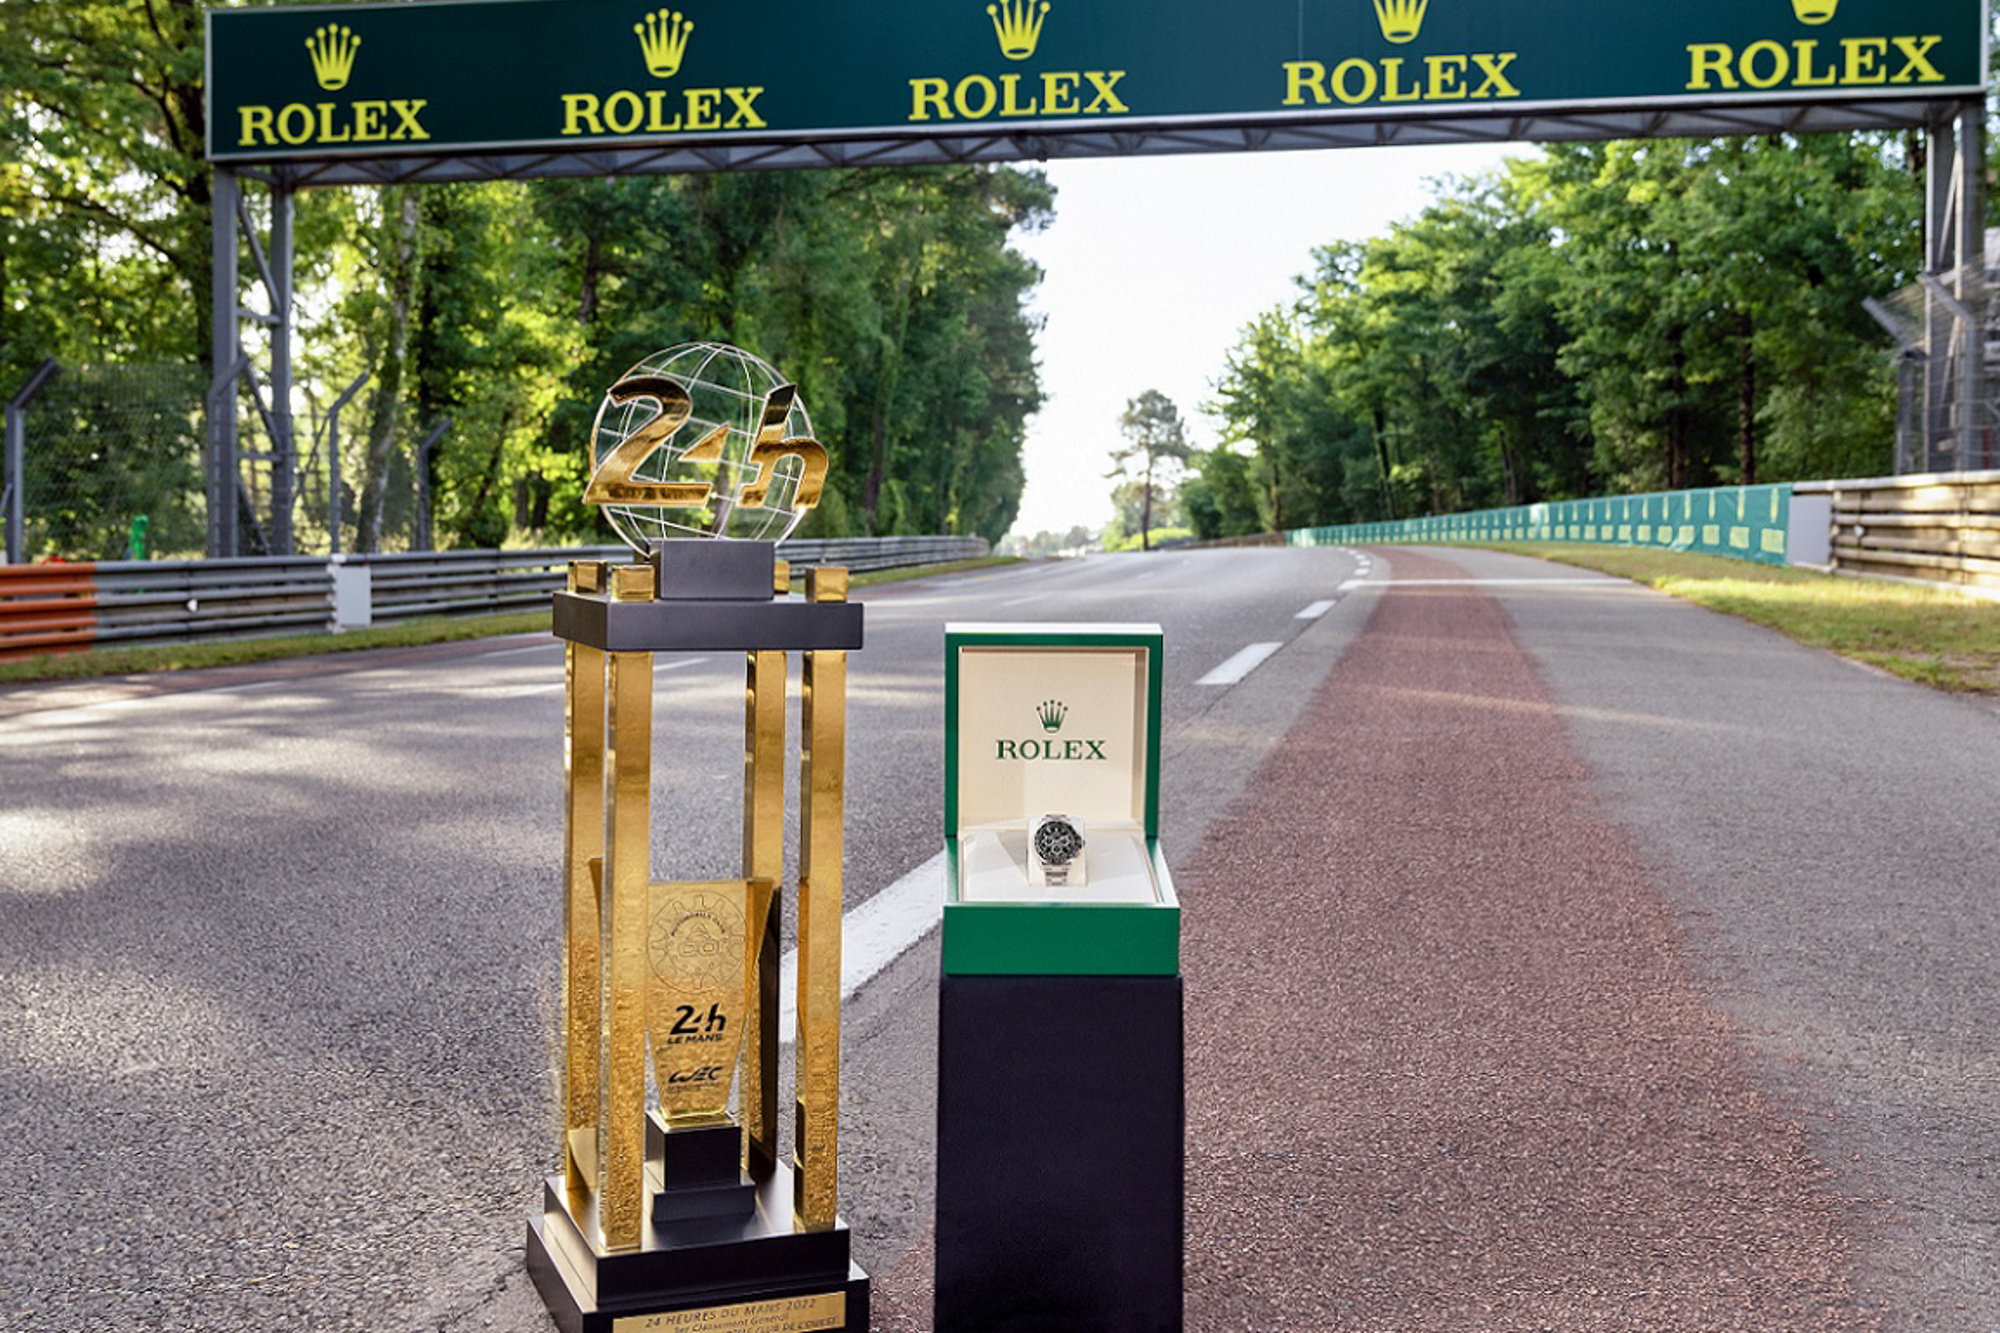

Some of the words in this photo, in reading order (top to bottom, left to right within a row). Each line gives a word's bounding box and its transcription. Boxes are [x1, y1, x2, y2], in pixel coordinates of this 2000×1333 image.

[1282, 52, 1521, 106] ROLEX
[1686, 35, 1945, 91] ROLEX
[561, 86, 767, 136] ROLEX
[908, 69, 1130, 122] ROLEX
[238, 99, 430, 146] ROLEX
[996, 739, 1107, 760] ROLEX
[667, 1036, 683, 1044] LE
[685, 1034, 723, 1043] MANS
[645, 1317, 661, 1328] 24
[665, 1311, 717, 1325] HEURES
[720, 1308, 740, 1319] DU
[744, 1302, 782, 1316] MANS
[786, 1298, 816, 1311] 2022
